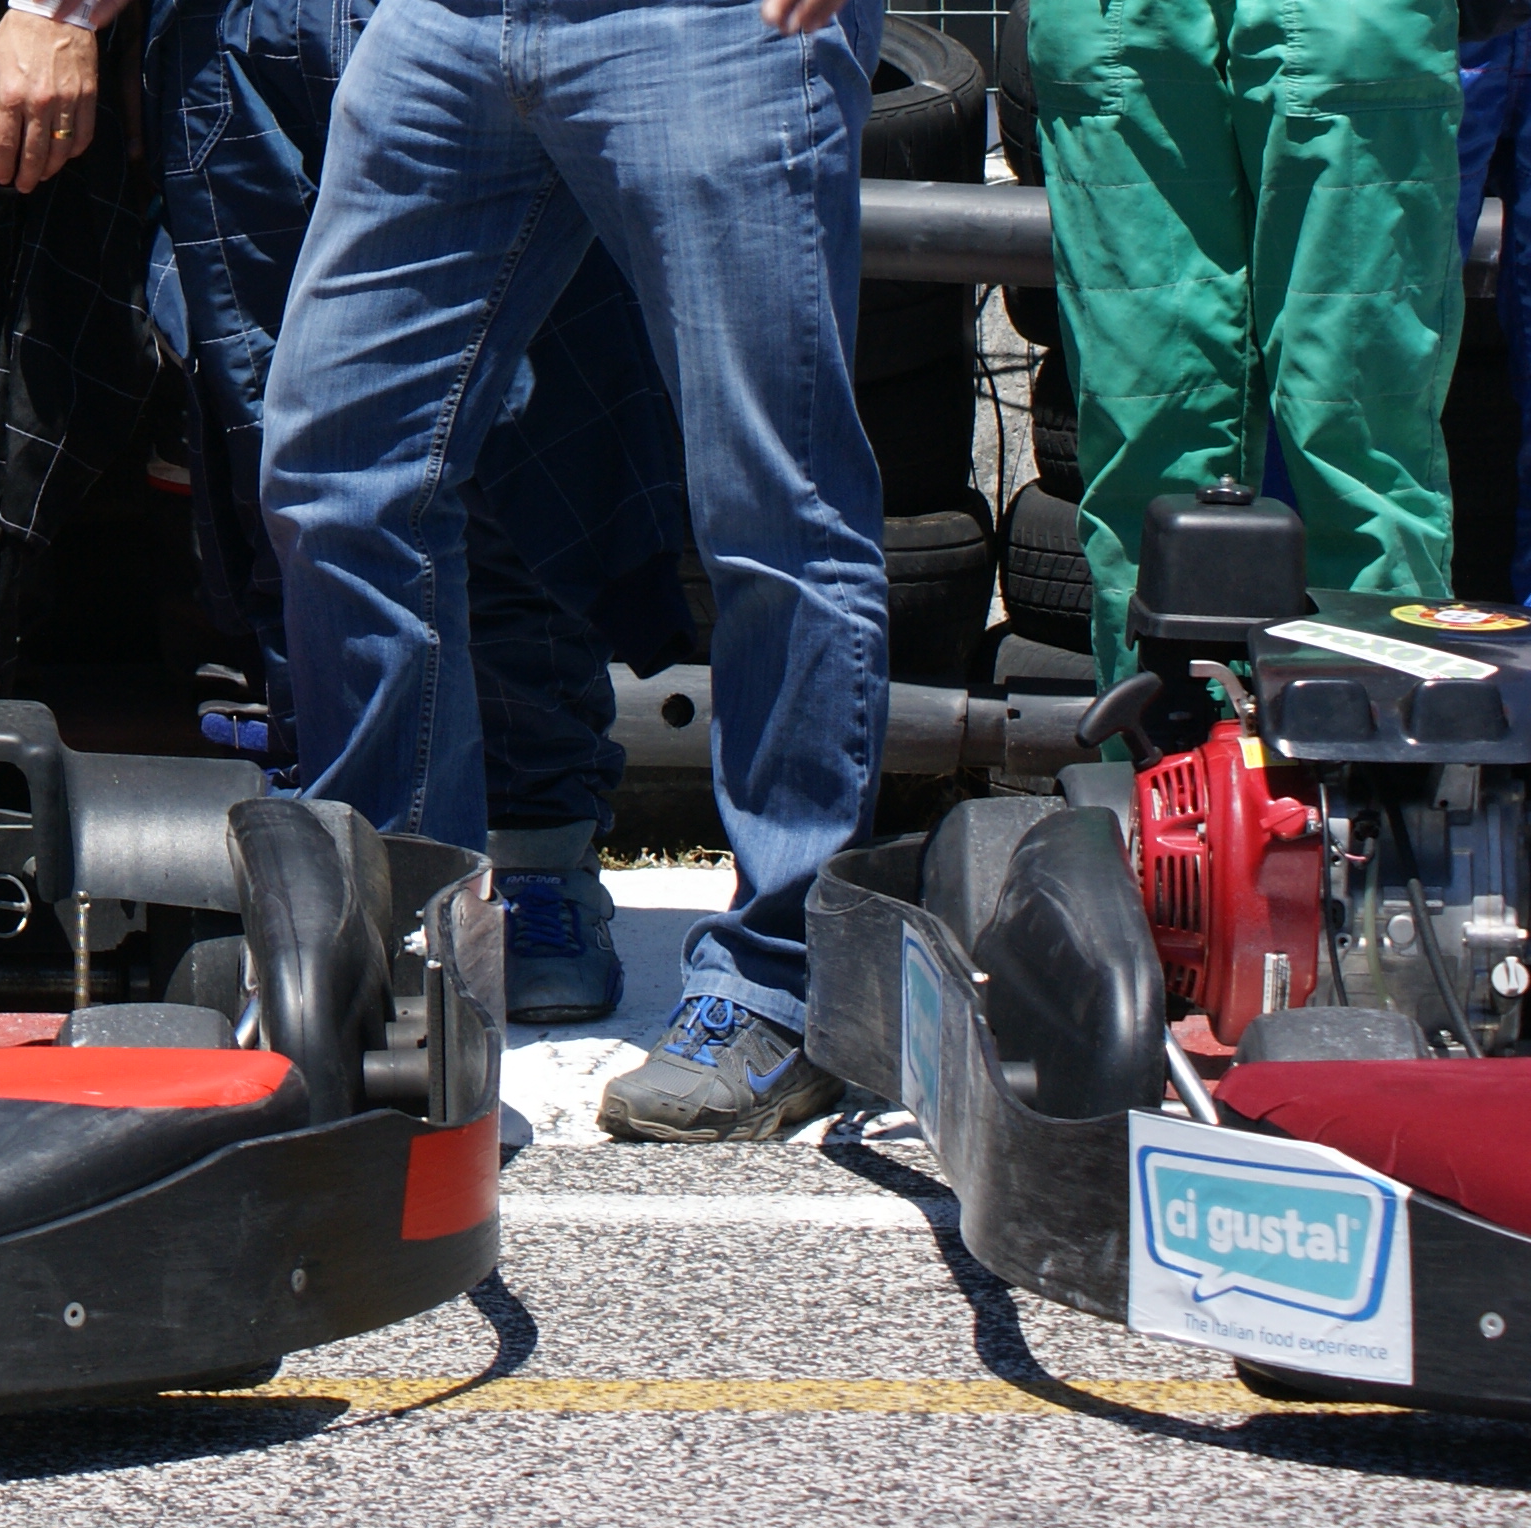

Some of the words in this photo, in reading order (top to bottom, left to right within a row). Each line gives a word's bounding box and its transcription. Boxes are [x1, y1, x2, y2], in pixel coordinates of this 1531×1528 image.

[506, 874, 561, 885] RACING
[1165, 1188, 1198, 1240] ci
[1206, 1204, 1350, 1264] gusta!
[1185, 1312, 1207, 1333] The
[1212, 1319, 1254, 1341] Italian
[1259, 1326, 1294, 1349] food
[1299, 1337, 1388, 1360] experience
